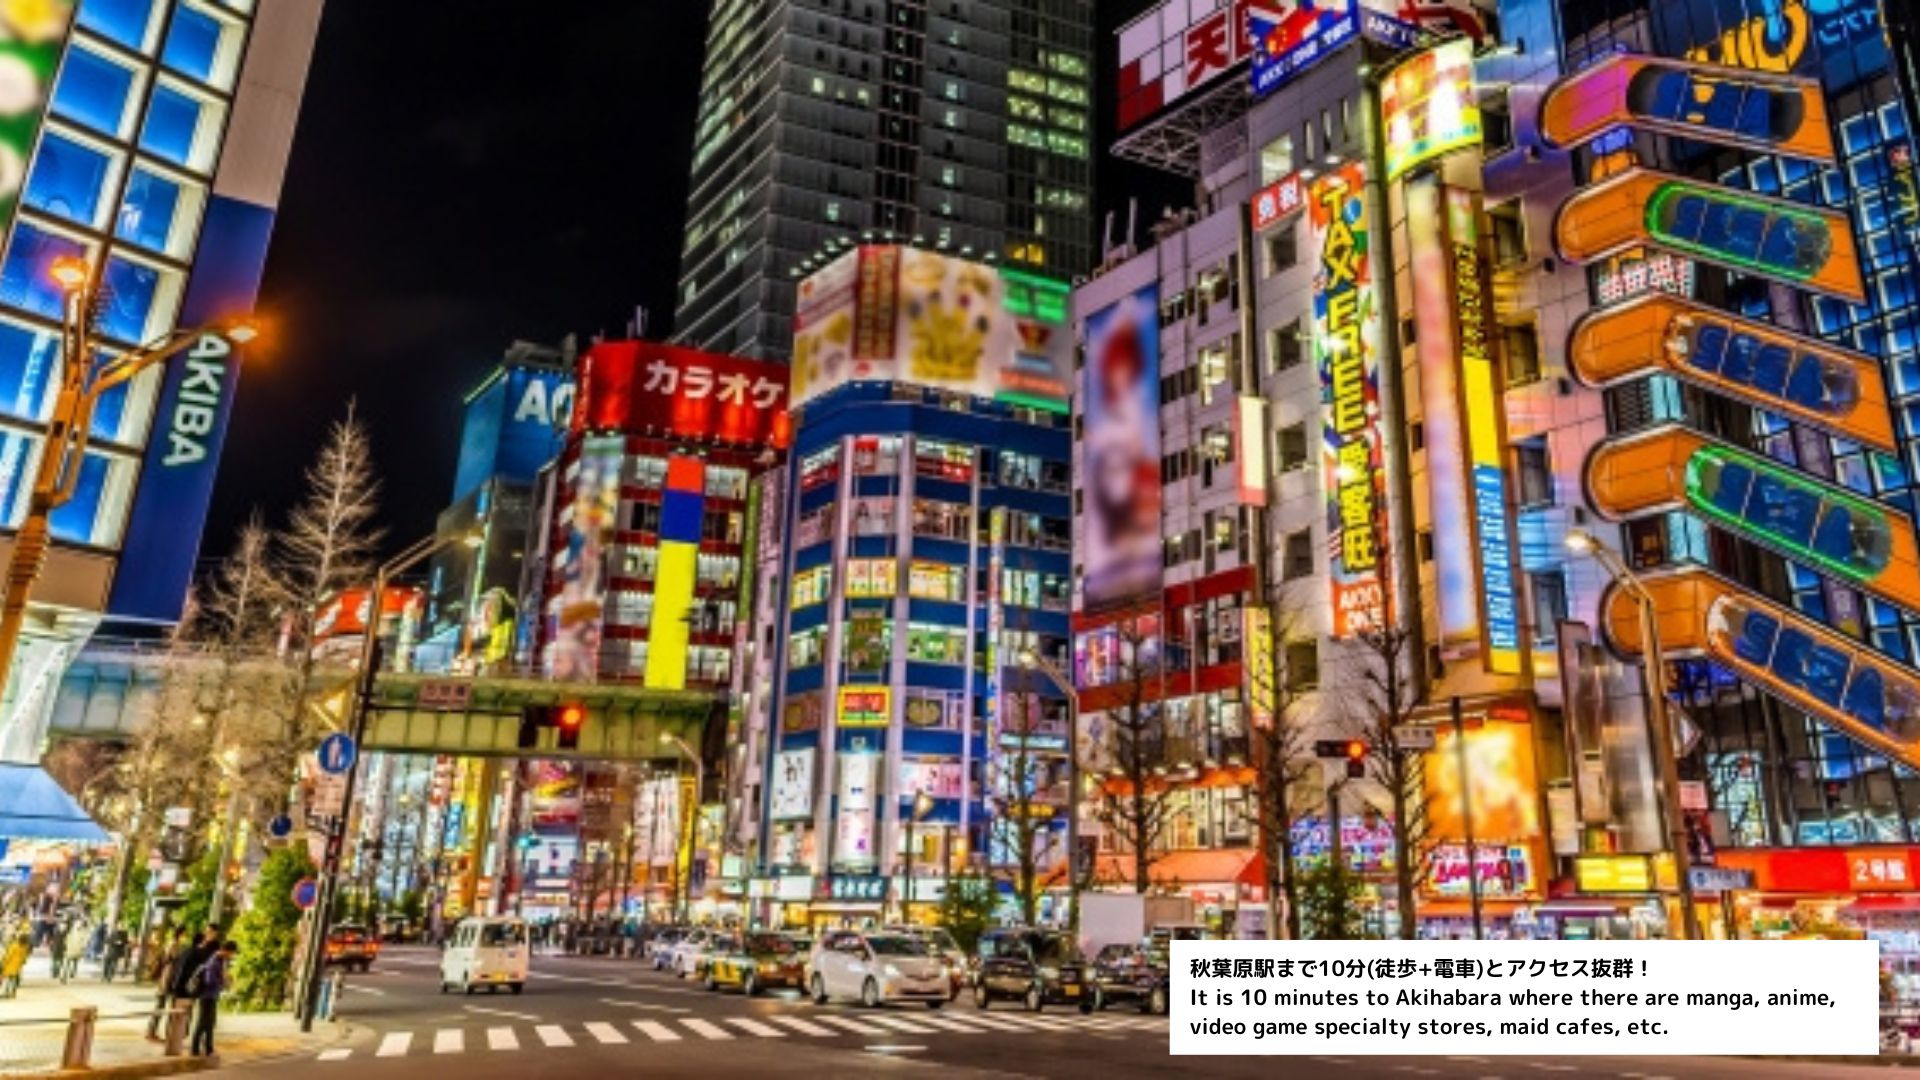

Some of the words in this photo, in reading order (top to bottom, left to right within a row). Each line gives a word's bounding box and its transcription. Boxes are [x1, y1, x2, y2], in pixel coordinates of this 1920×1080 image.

[1322, 181, 1355, 289] TAX
[161, 332, 231, 466] AKIBA
[643, 359, 785, 409] カラオケ
[1328, 288, 1366, 434] FREE
